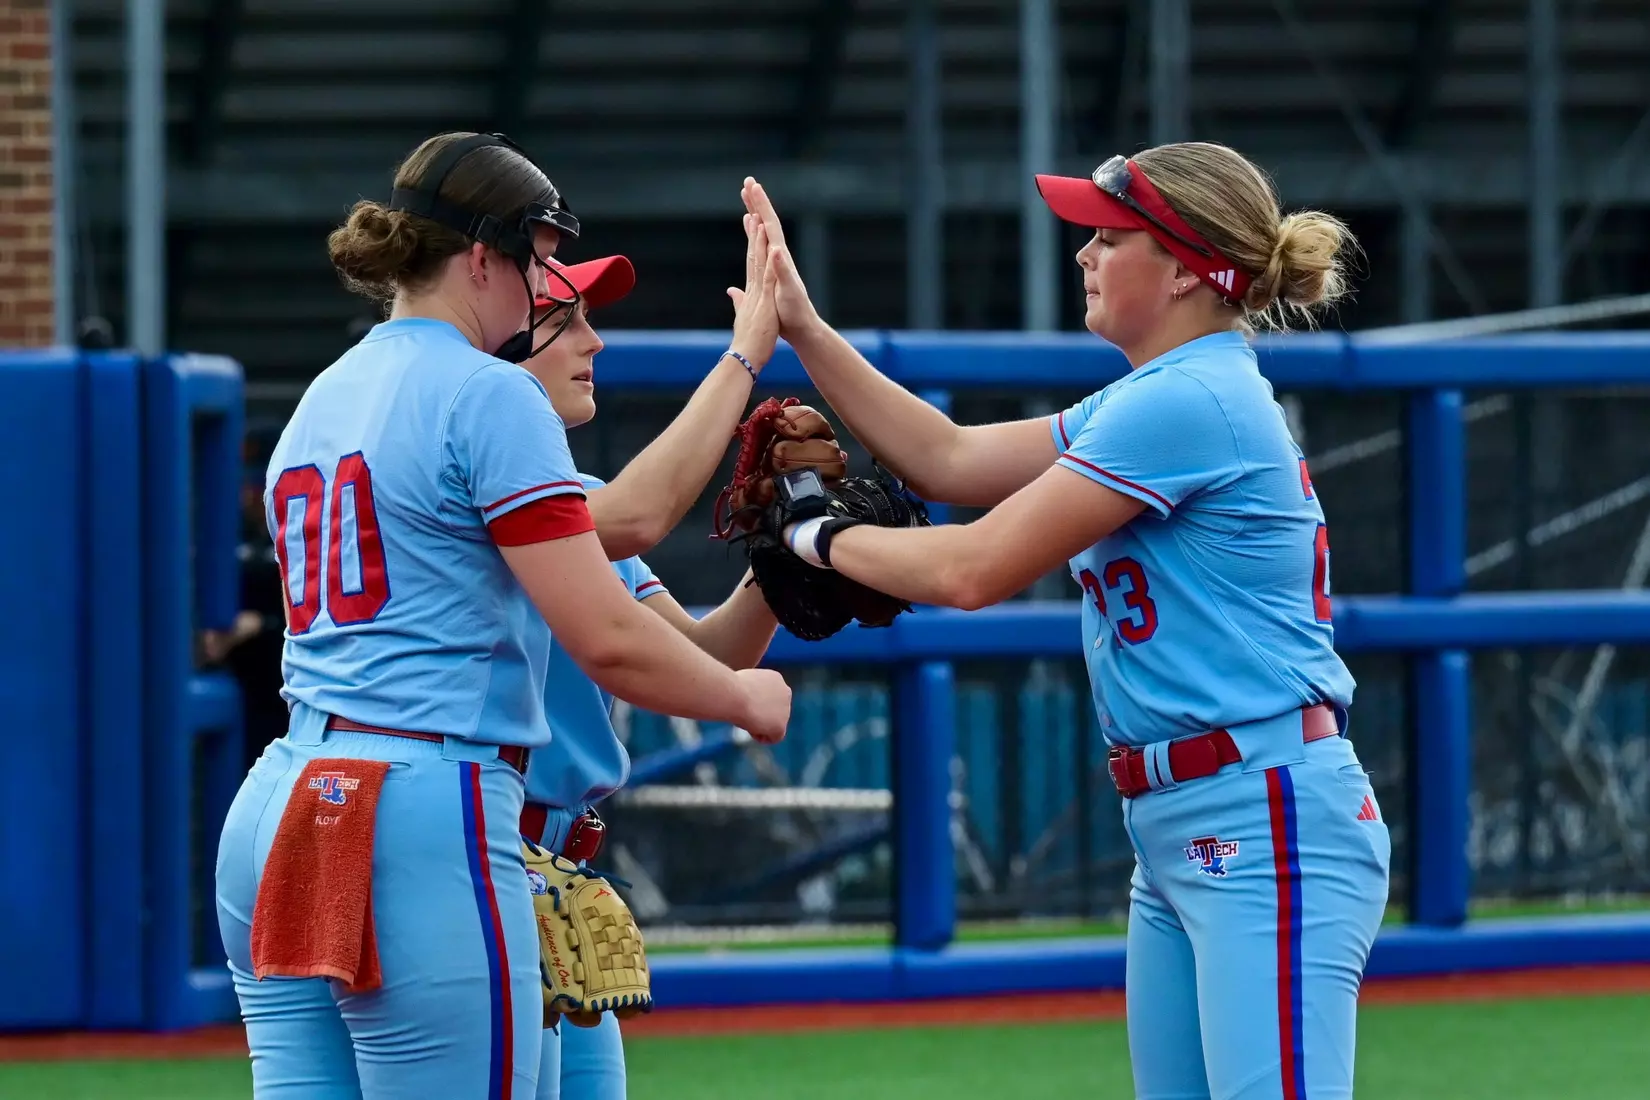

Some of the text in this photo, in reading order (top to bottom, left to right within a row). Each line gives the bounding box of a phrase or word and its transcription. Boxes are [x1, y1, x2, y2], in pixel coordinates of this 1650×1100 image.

[273, 450, 391, 635] 00
[1185, 836, 1238, 866] LA TECH
[536, 913, 570, 988] Audience of One
